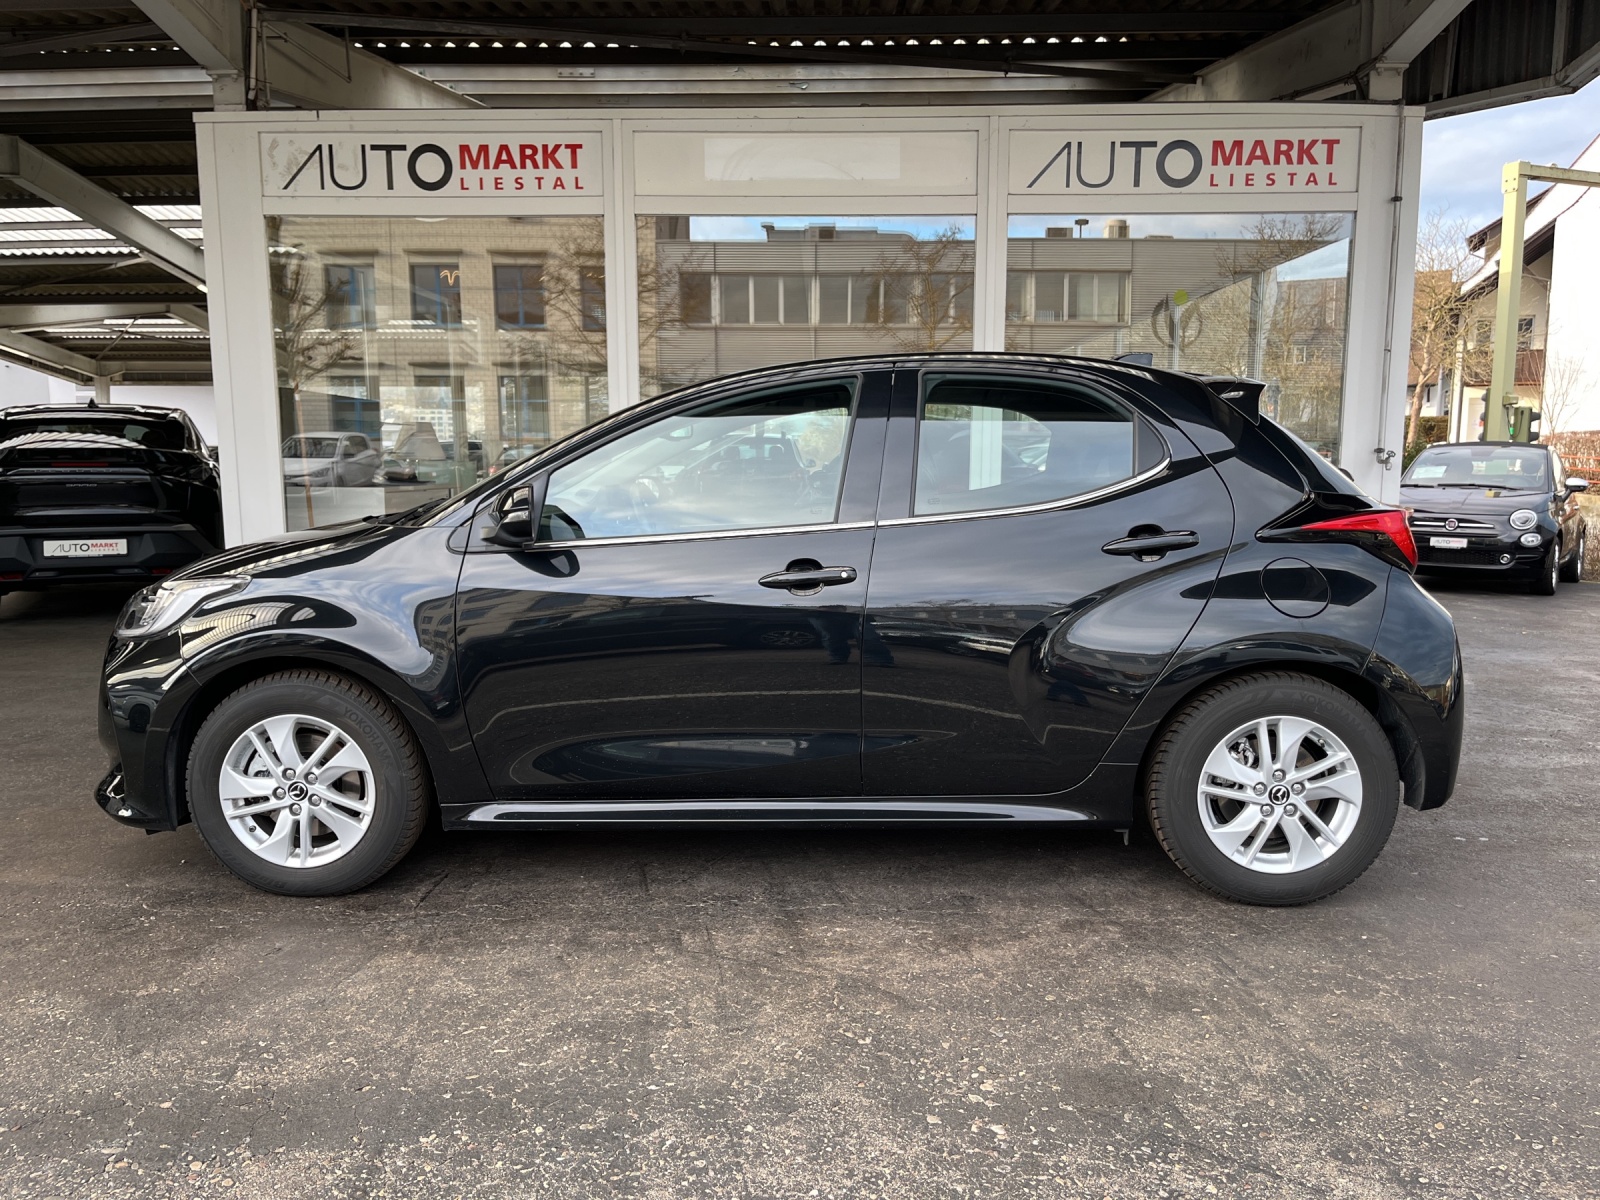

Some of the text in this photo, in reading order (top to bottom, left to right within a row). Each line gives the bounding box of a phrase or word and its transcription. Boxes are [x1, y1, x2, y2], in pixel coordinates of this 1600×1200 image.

[282, 143, 584, 191] AUTO MARKT
[1026, 138, 1341, 188] AUTO MARKT
[459, 176, 584, 191] LIESTAL
[1209, 172, 1338, 187] LIESTAL
